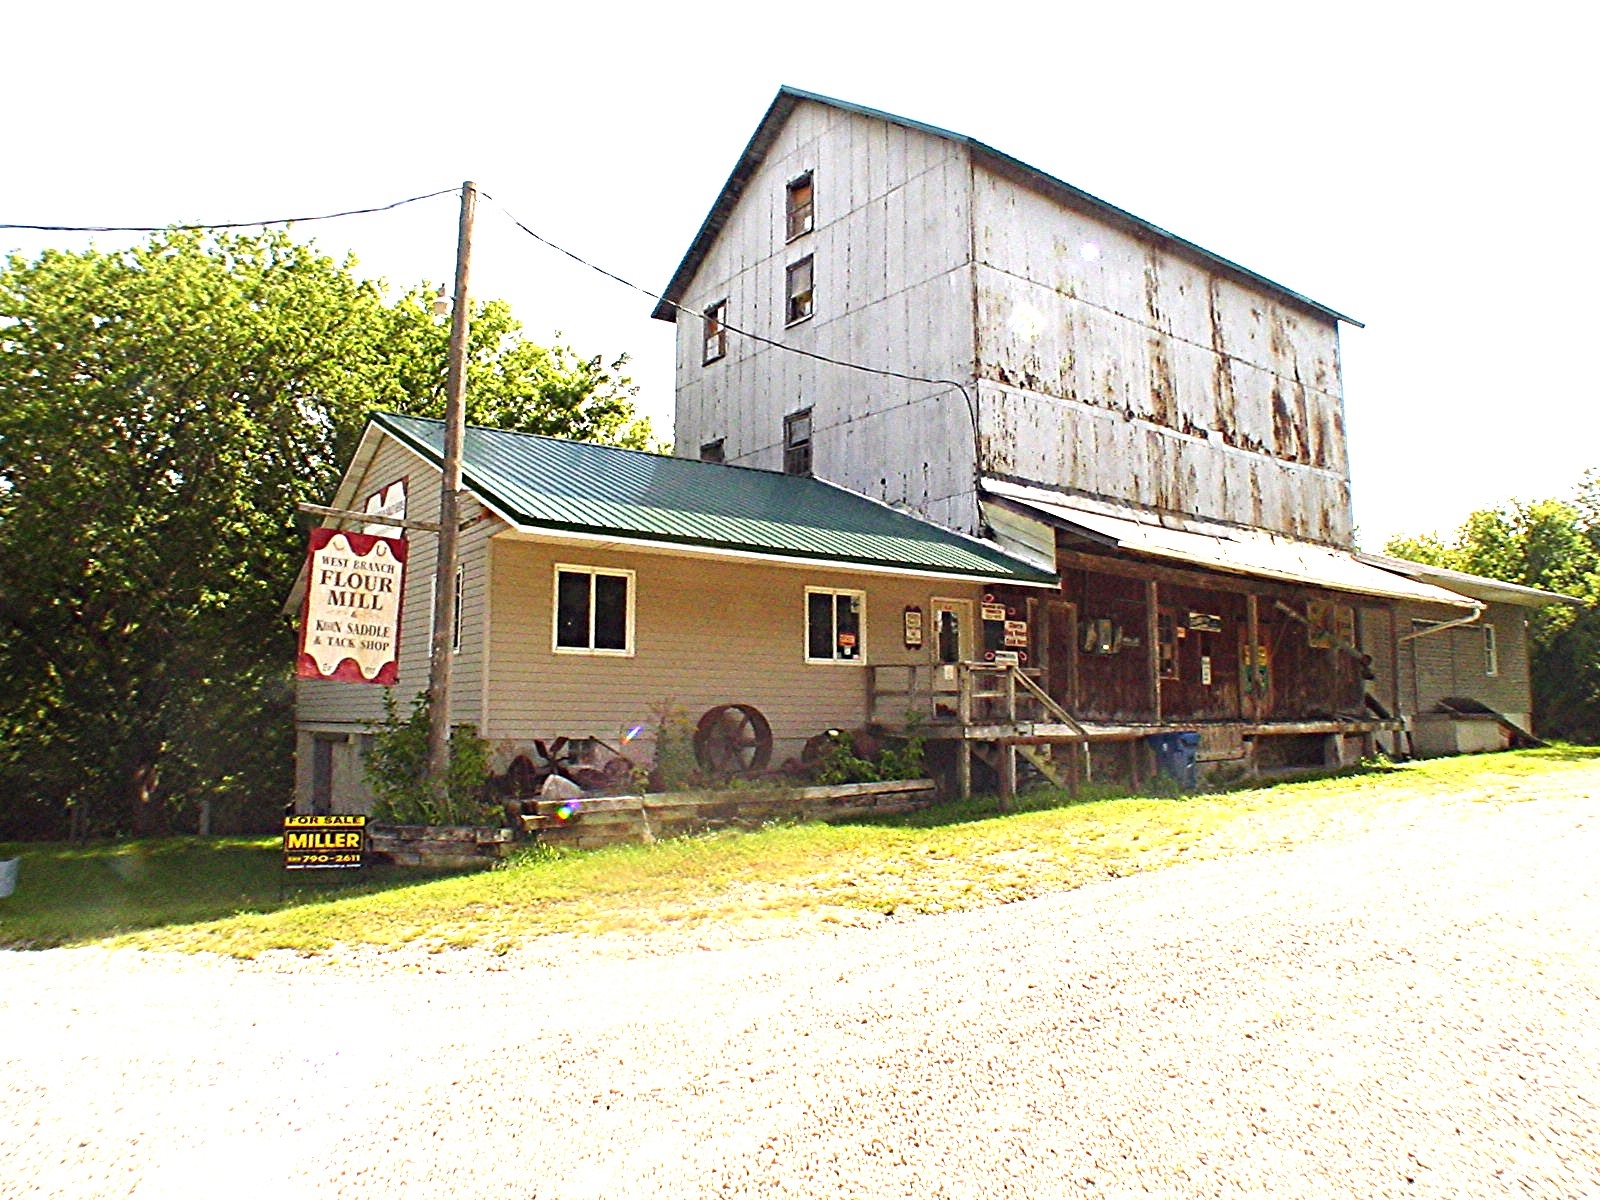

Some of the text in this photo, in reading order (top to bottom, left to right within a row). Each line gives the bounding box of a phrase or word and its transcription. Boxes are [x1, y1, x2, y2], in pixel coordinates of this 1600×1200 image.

[322, 556, 395, 574] WEST BRANCH
[319, 569, 393, 593] FLOUR
[327, 590, 383, 611] MILL
[347, 622, 391, 638] SADDLE
[314, 636, 390, 651] & TACK SHOP
[288, 816, 362, 824] FOR SALE
[288, 833, 360, 849] MILLER
[302, 854, 361, 863] 790-2611
